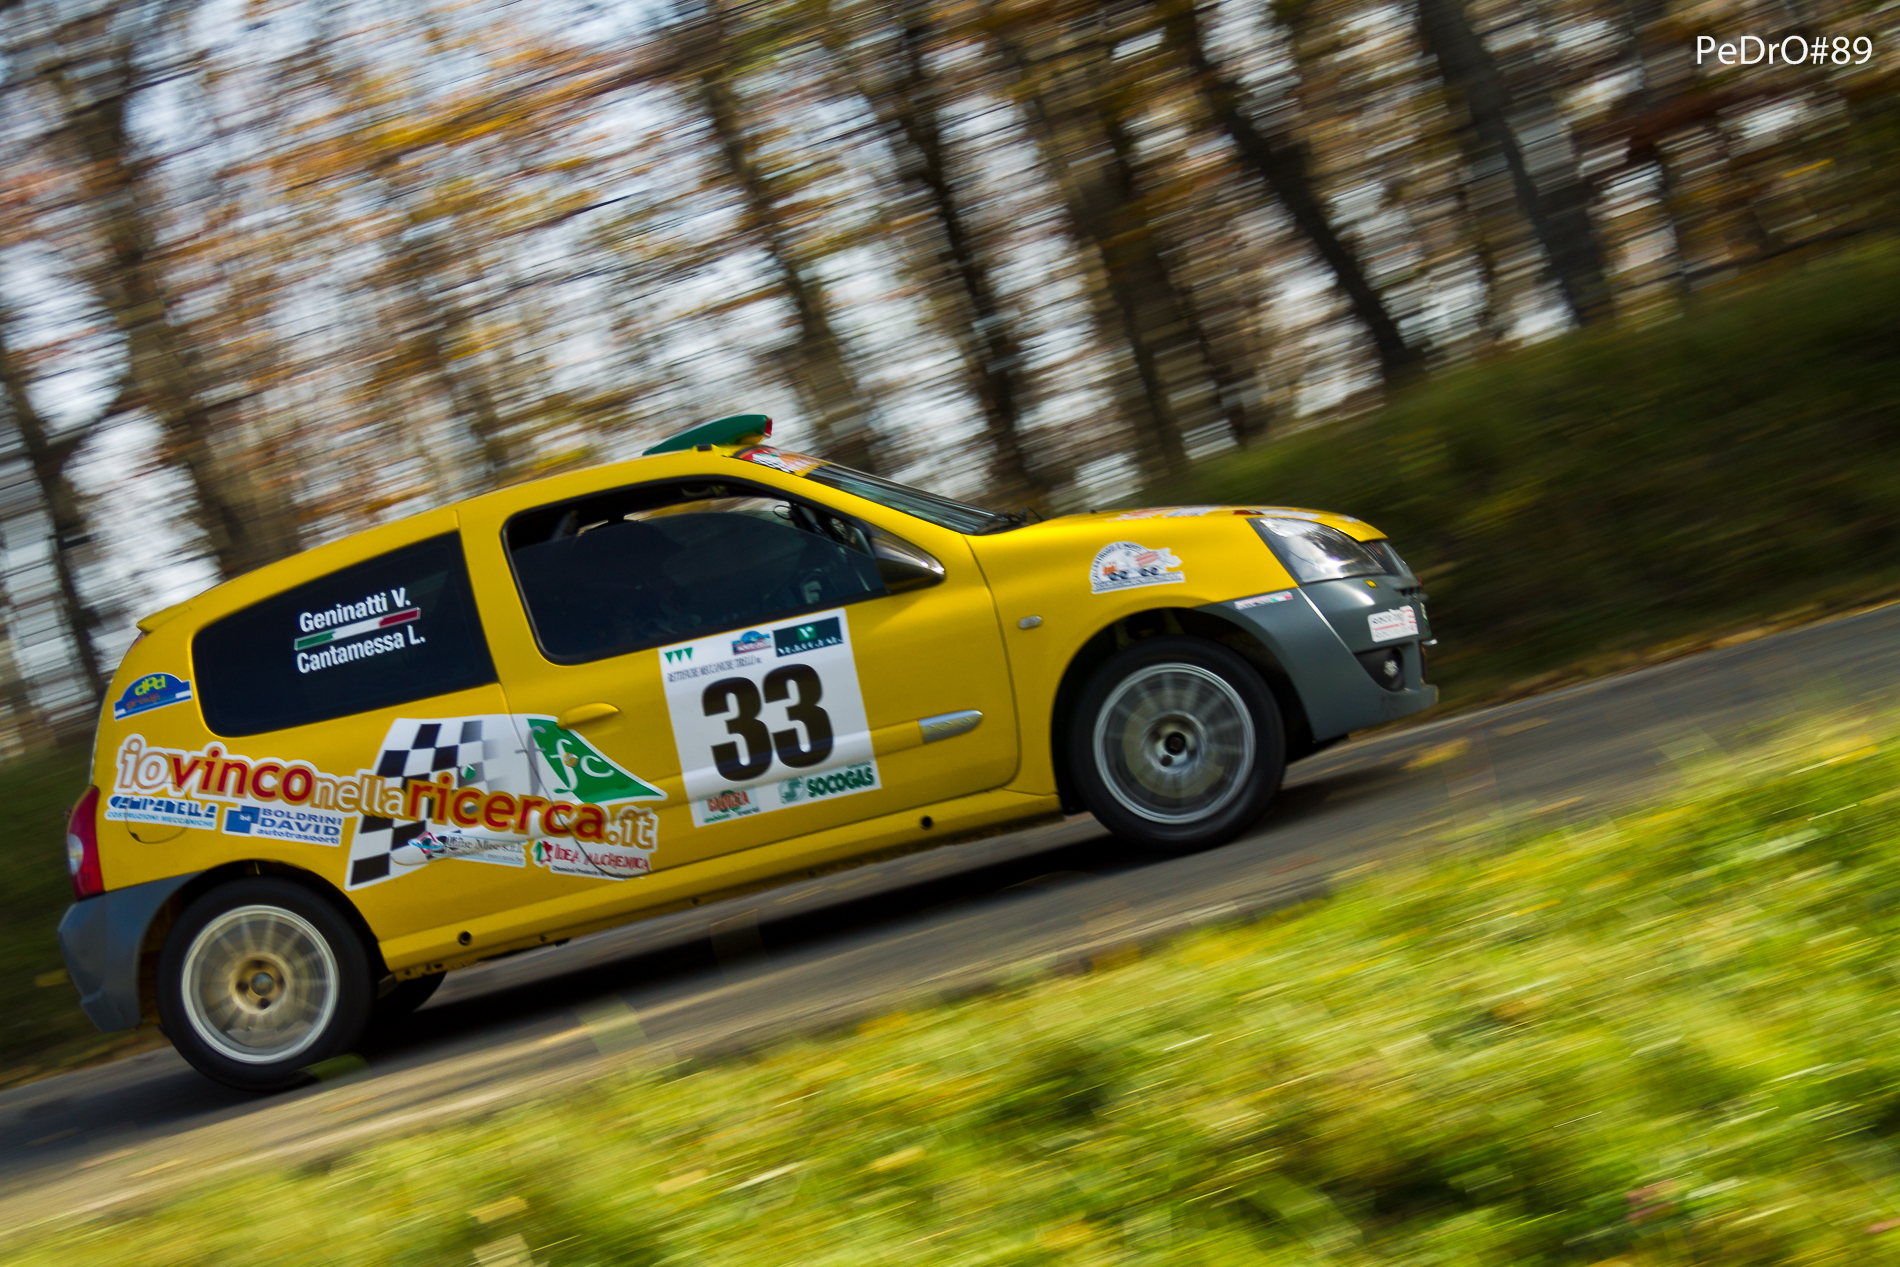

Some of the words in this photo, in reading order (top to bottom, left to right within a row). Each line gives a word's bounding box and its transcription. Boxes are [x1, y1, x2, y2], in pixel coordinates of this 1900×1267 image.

[299, 592, 388, 632] Geninatti
[391, 587, 411, 608] V.
[297, 632, 405, 674] Cantamessa
[407, 625, 426, 645] L.
[702, 663, 834, 782] 33
[807, 767, 874, 798] SOCOGAS
[260, 817, 340, 836] DAVID
[262, 808, 342, 826] BOLDRINI
[256, 829, 339, 844] autotrasporti
